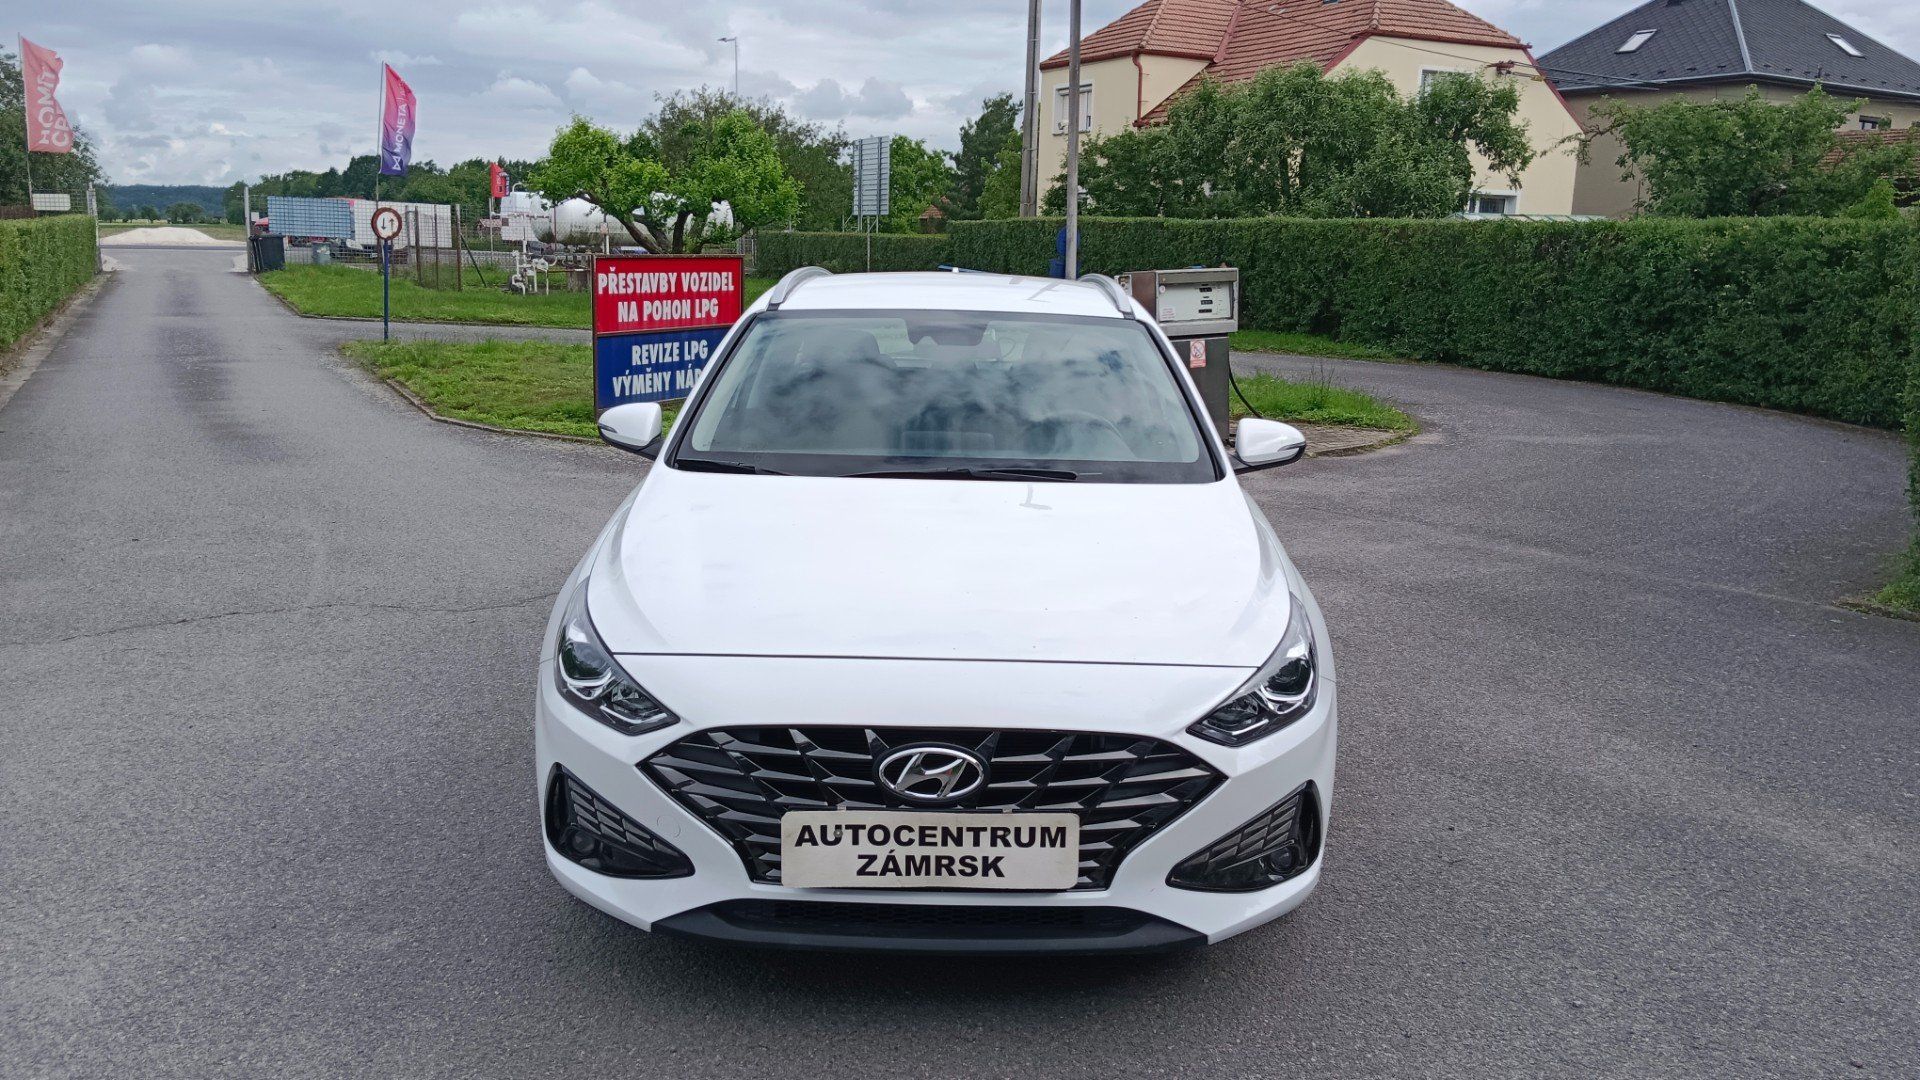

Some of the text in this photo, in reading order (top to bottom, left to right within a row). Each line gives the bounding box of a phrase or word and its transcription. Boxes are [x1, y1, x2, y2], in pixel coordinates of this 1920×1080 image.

[394, 103, 408, 154] MONETA
[597, 266, 735, 295] PŘESTAVBY VOZIDEL
[617, 298, 719, 323] NA POHON LPG
[631, 339, 709, 366] REVIZE LPG
[612, 366, 672, 397] VÝMĚNY
[795, 823, 1067, 848] AUTOCENTRUM
[855, 848, 1005, 878] ZÁMRSK
